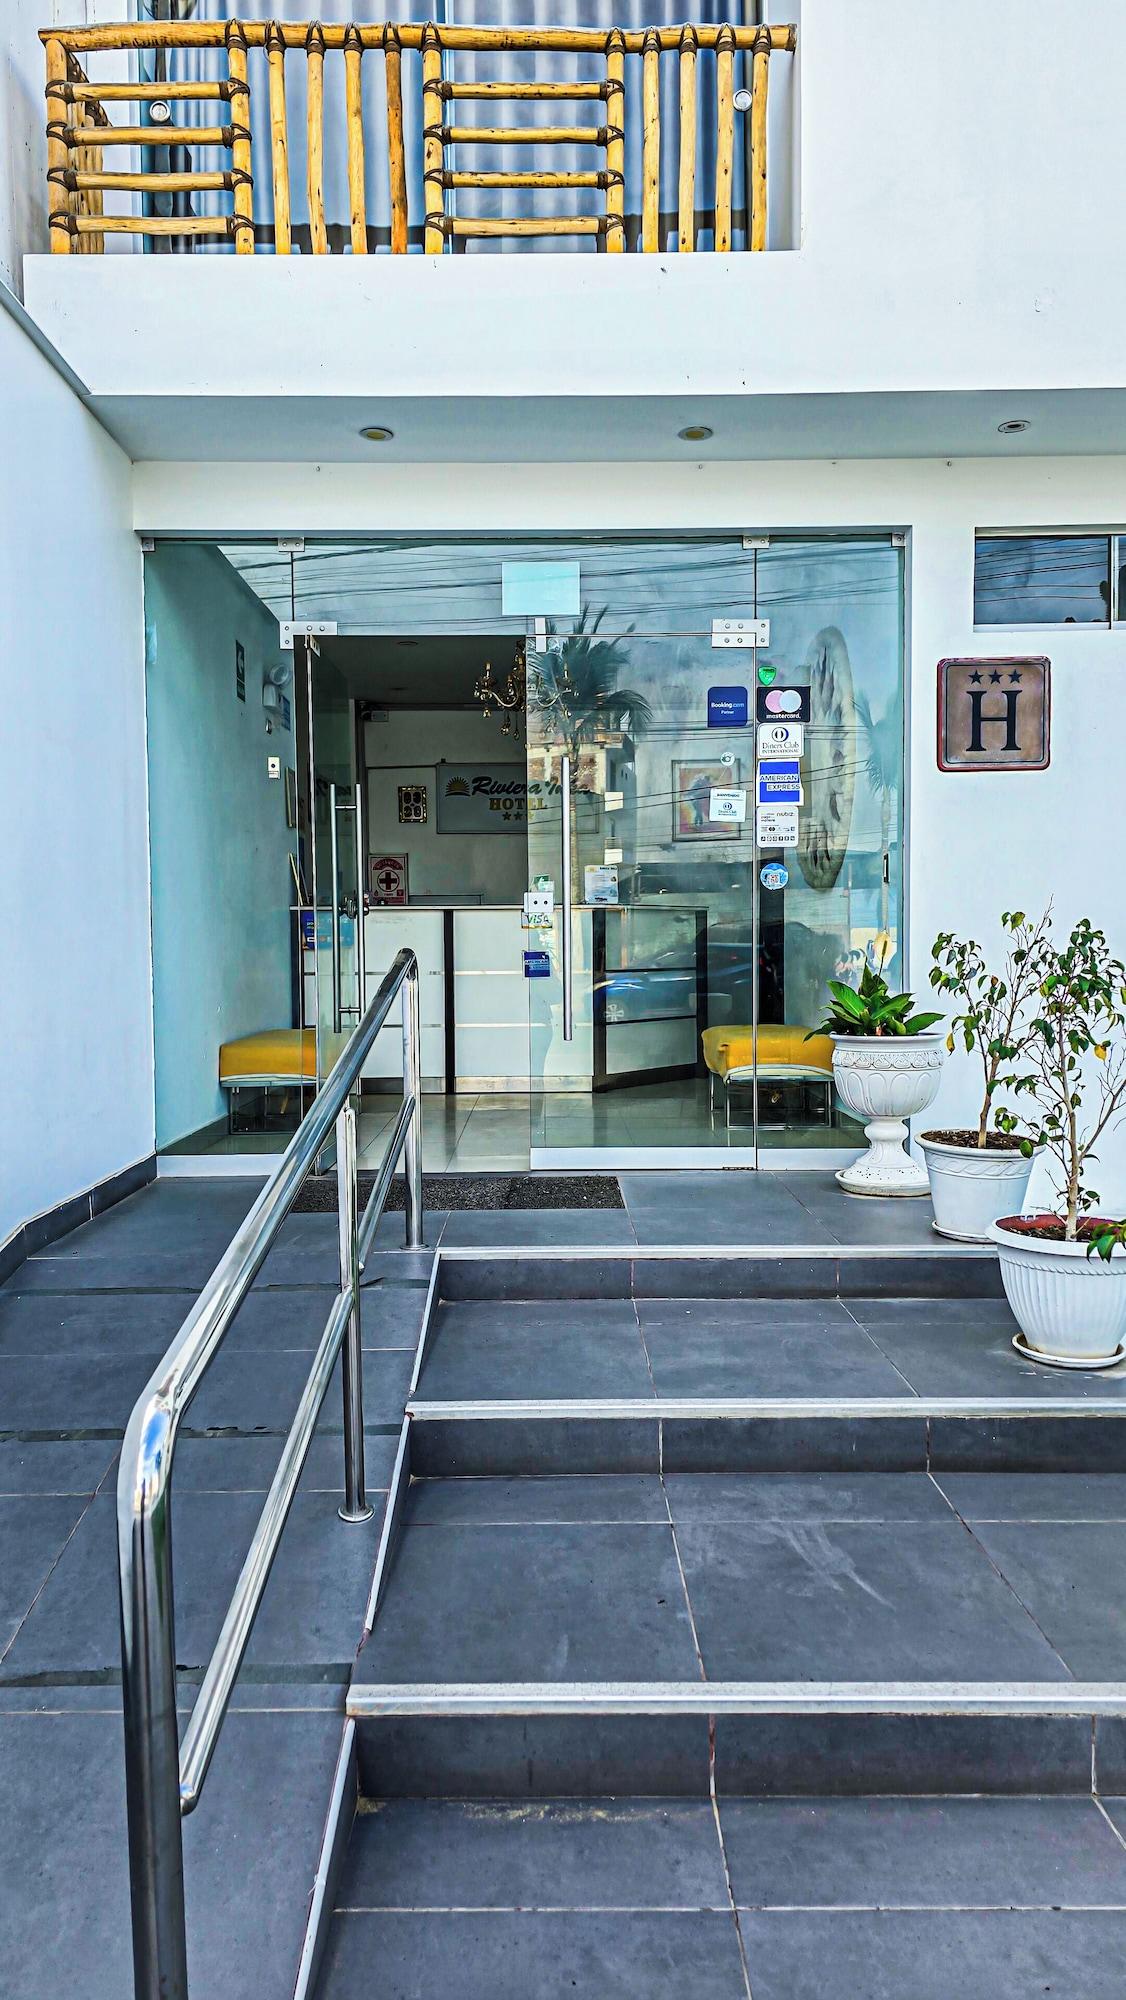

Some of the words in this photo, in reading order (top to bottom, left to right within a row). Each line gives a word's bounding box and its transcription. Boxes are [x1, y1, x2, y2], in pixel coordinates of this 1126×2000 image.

[966, 690, 1023, 751] H
[762, 742, 783, 750] Diners
[784, 741, 800, 749] Club
[471, 776, 543, 796] Riviera
[489, 797, 548, 810] HOTEL
[525, 914, 550, 924] VISA
